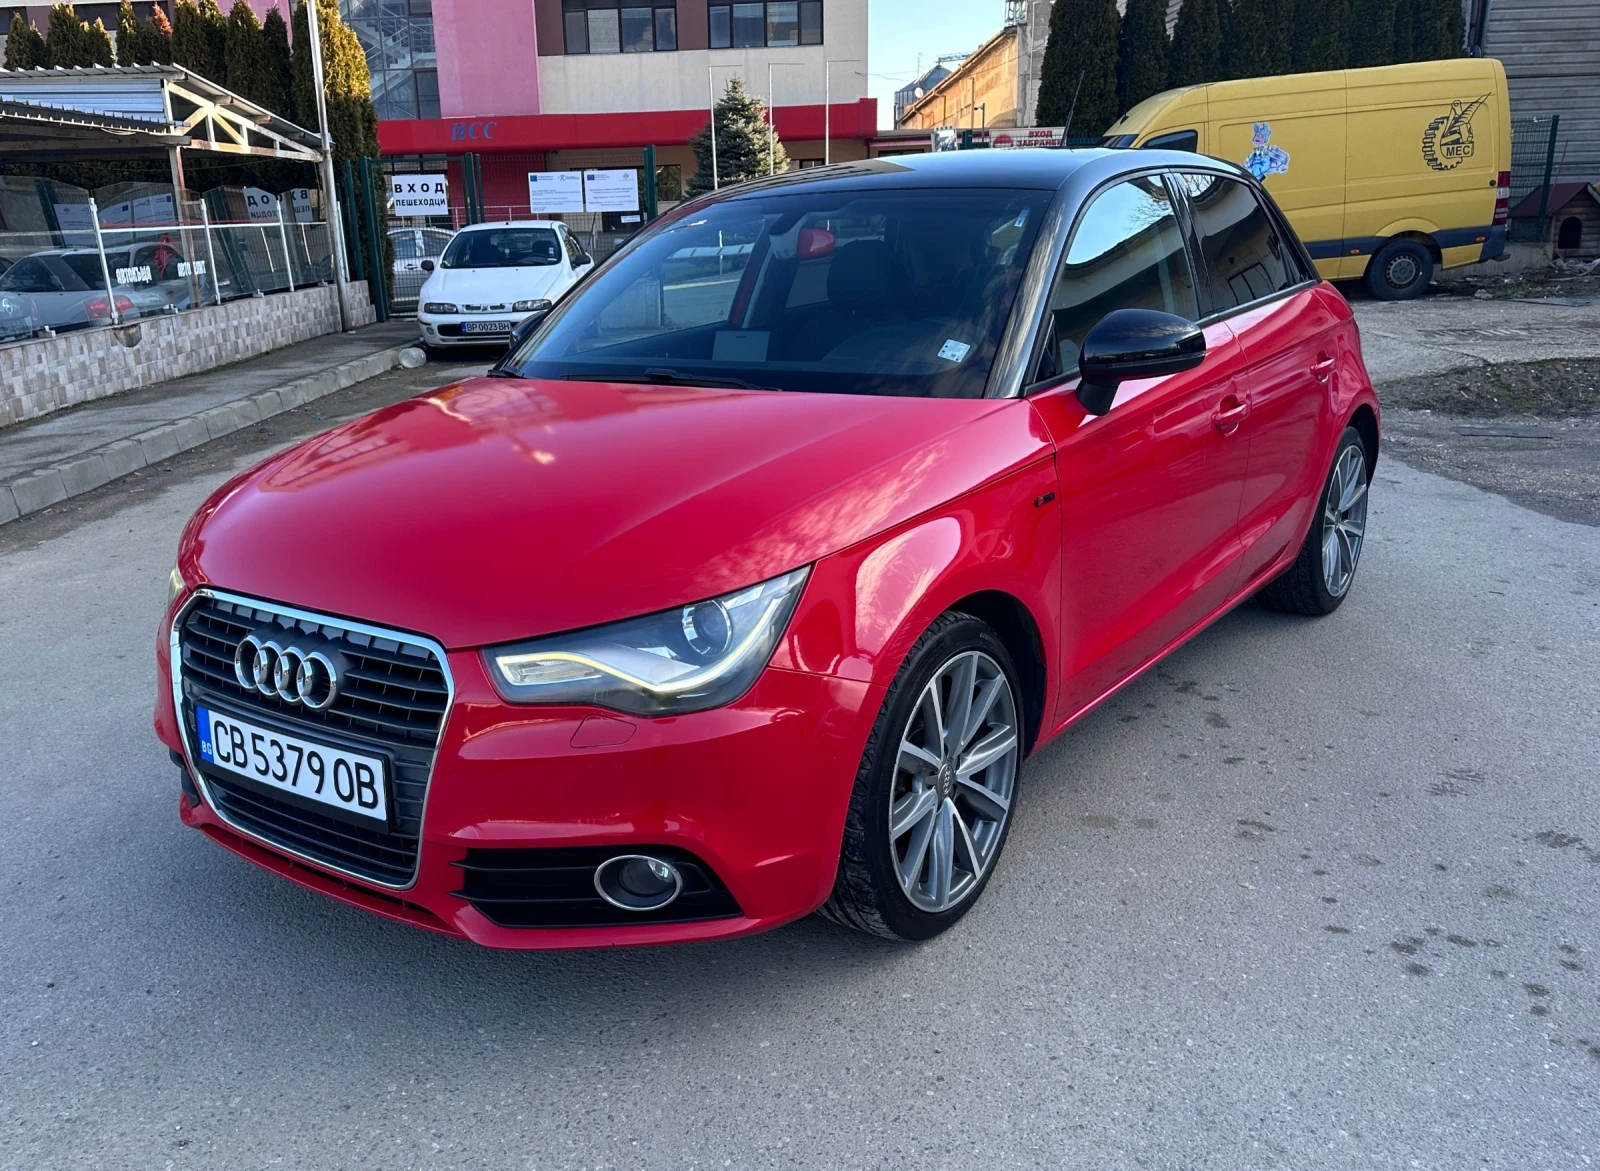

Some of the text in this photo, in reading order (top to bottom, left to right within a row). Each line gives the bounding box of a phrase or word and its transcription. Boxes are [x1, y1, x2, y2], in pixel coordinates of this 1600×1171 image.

[452, 121, 497, 141] ИСС
[1028, 130, 1053, 139] ВХОД
[394, 182, 445, 194] ВХОД
[395, 198, 446, 207] ПЕШЕХОДЦИ
[478, 321, 498, 331] 0023
[202, 740, 212, 755] BG
[251, 732, 325, 794] 5379
